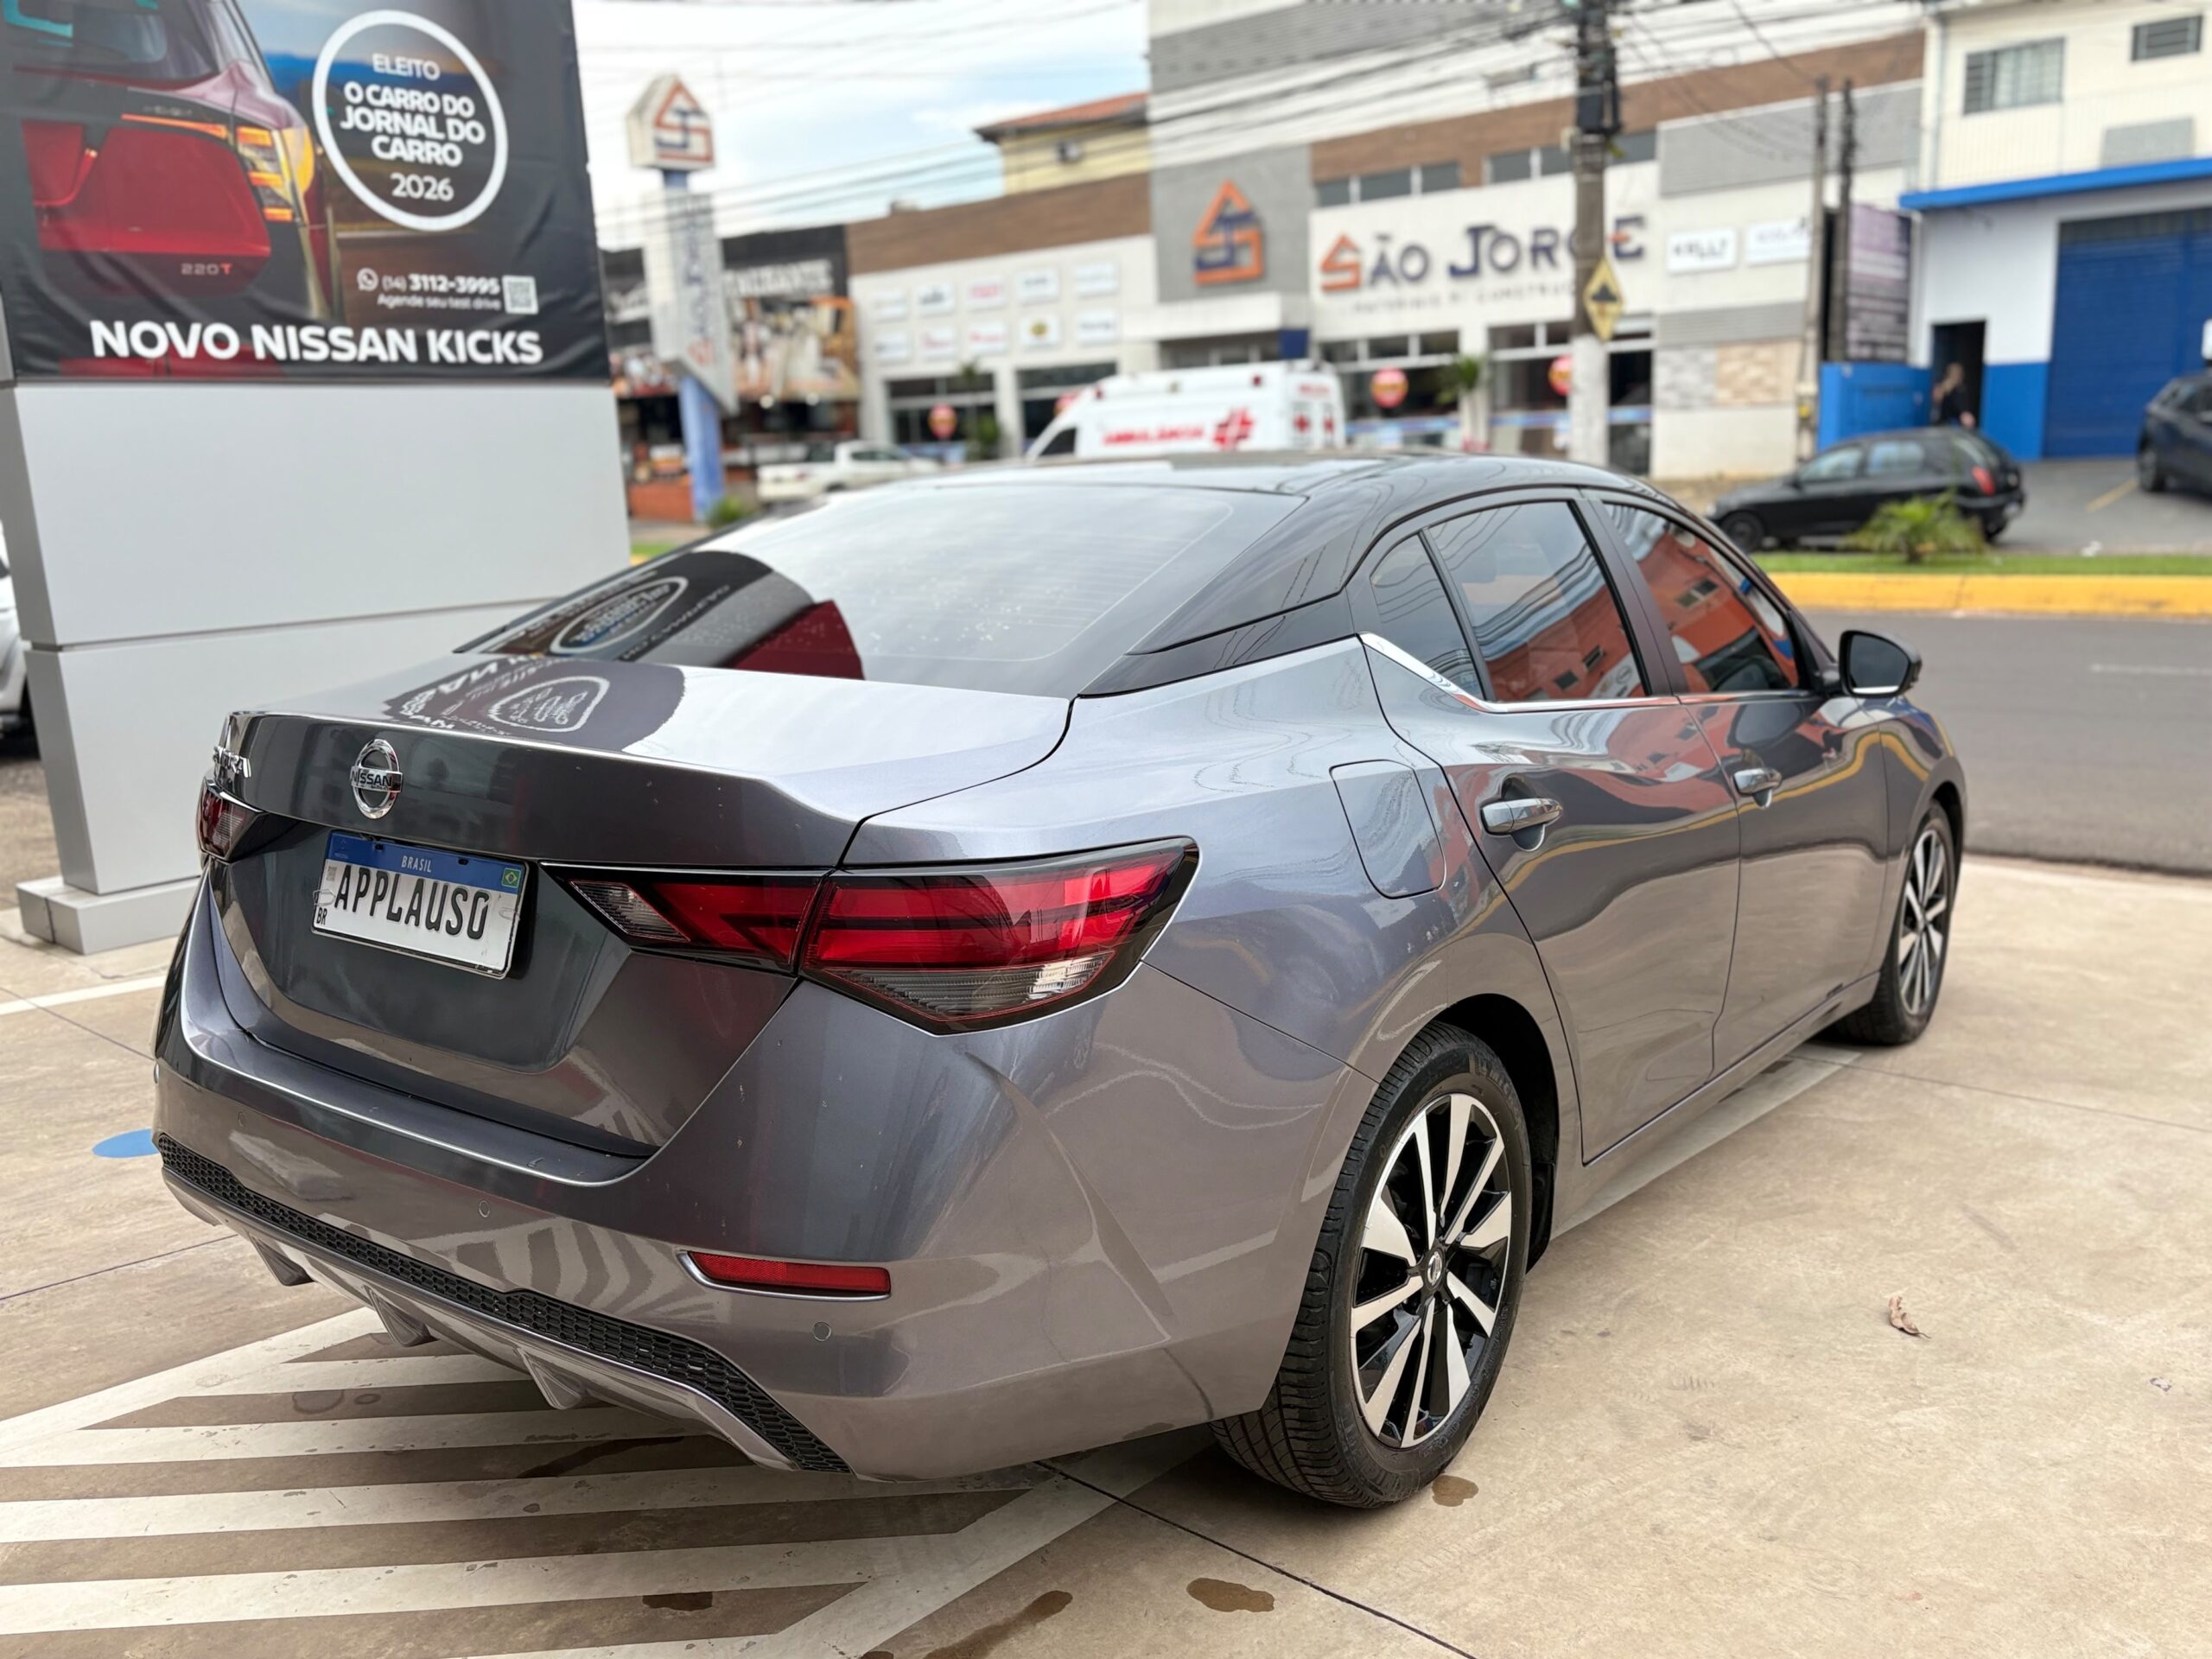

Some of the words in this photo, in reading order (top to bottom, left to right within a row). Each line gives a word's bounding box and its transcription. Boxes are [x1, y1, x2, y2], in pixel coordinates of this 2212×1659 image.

[372, 53, 440, 80] ELEITO
[344, 81, 364, 104] O
[365, 84, 441, 113] CARRO
[442, 94, 475, 118] DO
[340, 105, 446, 140] JORNAL
[446, 118, 486, 144] DO
[372, 135, 463, 167] CARRO
[391, 173, 454, 201] 2026
[1448, 216, 1645, 277] JORE
[181, 263, 232, 276] 220T
[89, 321, 240, 359] NOVO
[251, 324, 418, 362] NISSAN
[426, 328, 543, 364] KICKS
[351, 770, 392, 787] NISSAN
[401, 855, 432, 873] BRASIL
[316, 906, 327, 925] BR
[334, 865, 490, 940] APPLAUSO
